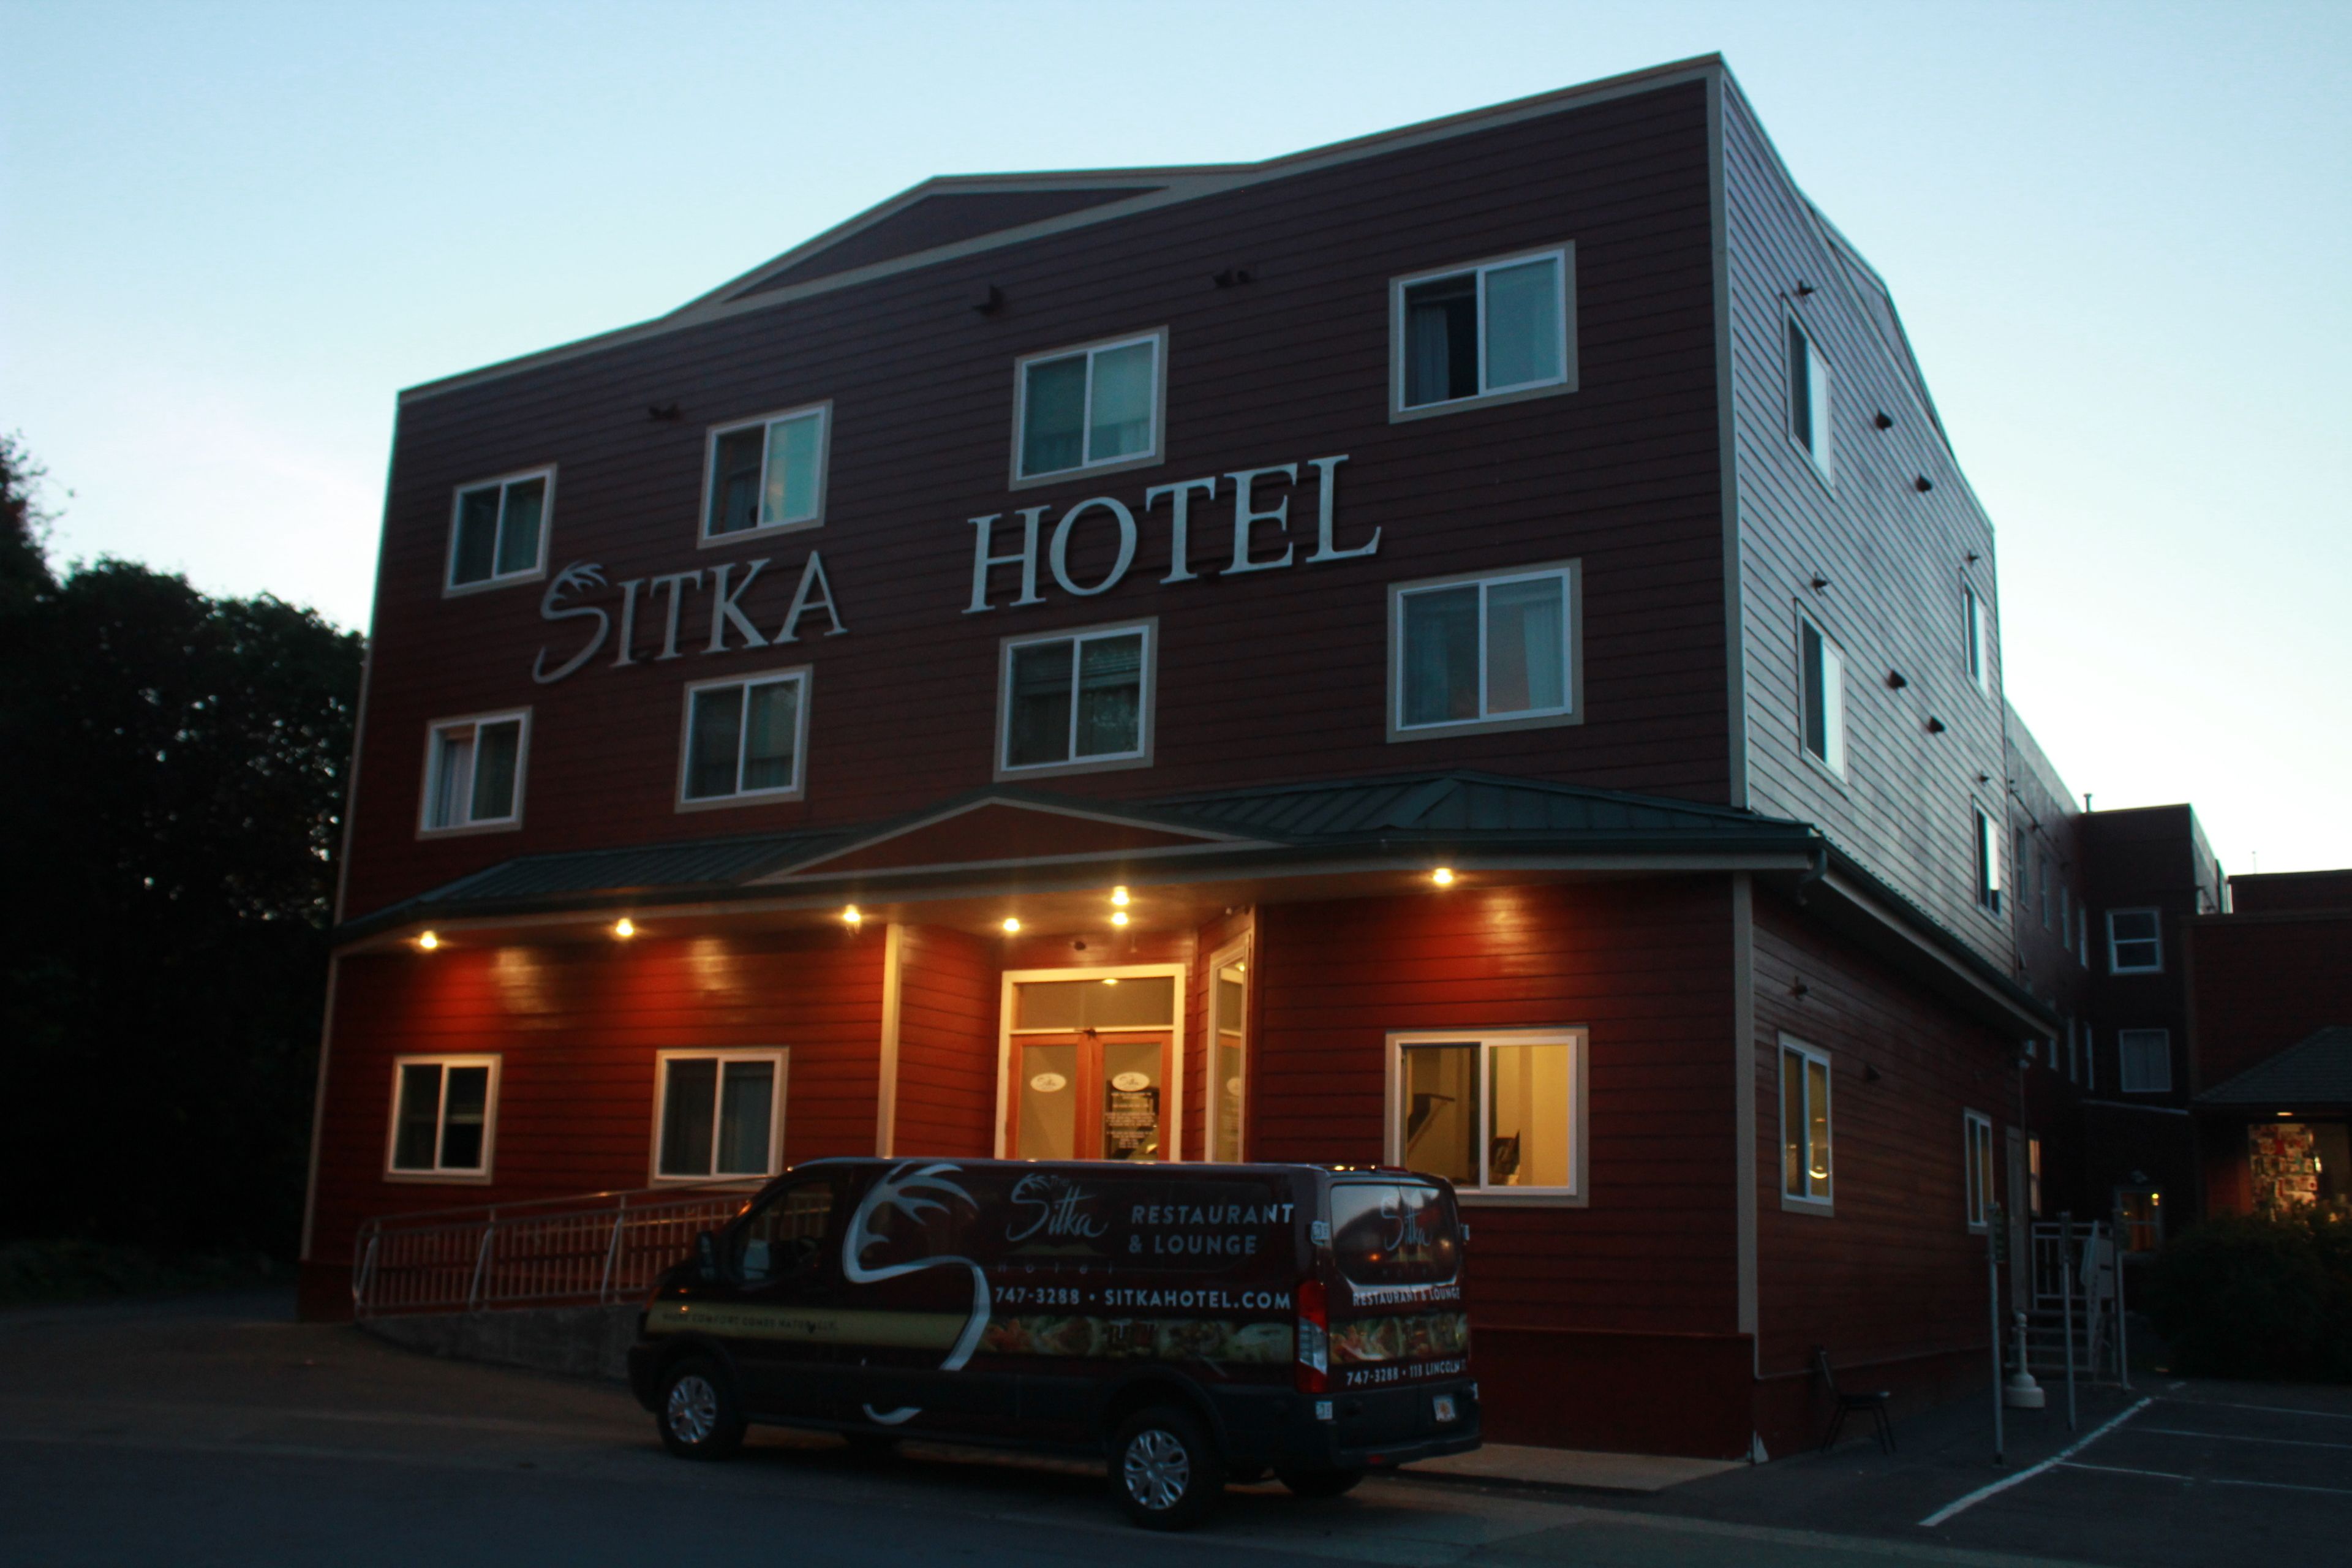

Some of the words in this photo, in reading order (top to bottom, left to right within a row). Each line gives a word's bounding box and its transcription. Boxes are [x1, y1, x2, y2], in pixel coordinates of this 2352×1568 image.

[532, 549, 848, 684] SITKA
[962, 454, 1383, 614] HOTEL
[1006, 1172, 1109, 1242] Sitka
[1131, 1203, 1294, 1225] RESTAURANT
[1128, 1234, 1142, 1254] &
[1155, 1234, 1257, 1255] LOUNGE
[995, 1287, 1080, 1305] 747-3288
[1104, 1289, 1291, 1310] SITKAHOTEL.COM
[1352, 1289, 1418, 1306] RESTAURANT
[1430, 1286, 1461, 1302] LOUNGE
[1347, 1366, 1400, 1386] 747-3288
[1425, 1359, 1460, 1376] LINCOLN
